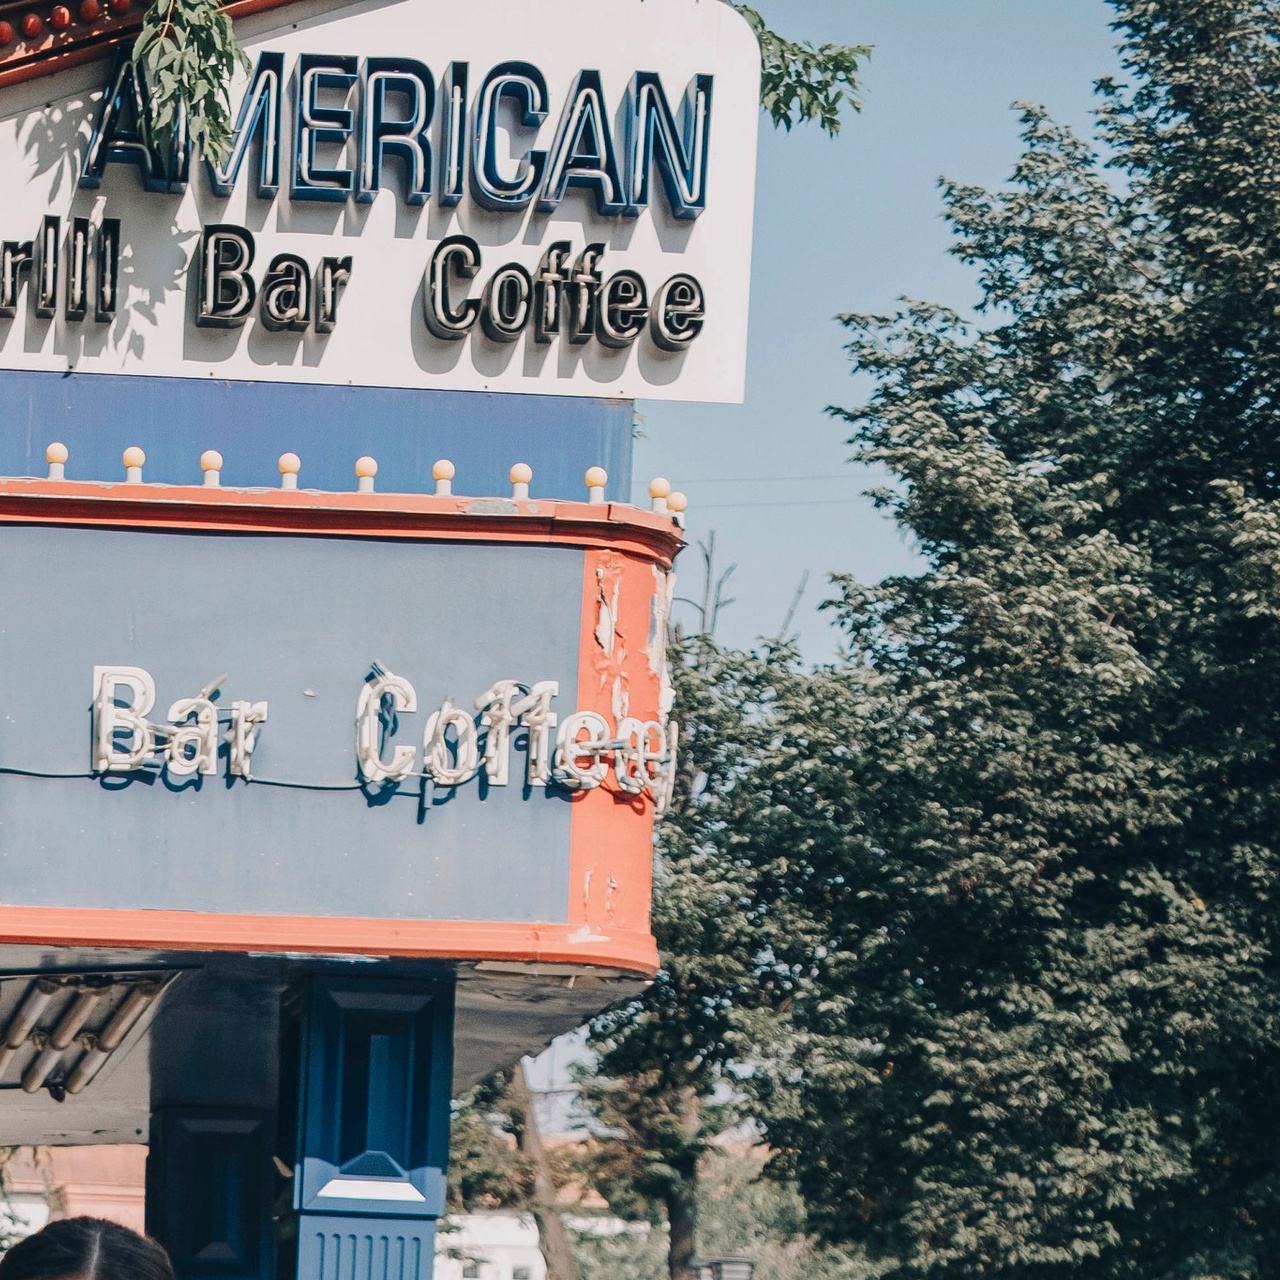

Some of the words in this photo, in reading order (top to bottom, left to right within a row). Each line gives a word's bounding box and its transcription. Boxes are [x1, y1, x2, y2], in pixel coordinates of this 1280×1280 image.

[80, 46, 713, 218] AMERICAN
[195, 224, 353, 329] Bar
[425, 236, 707, 353] Coffee
[92, 665, 270, 776] Bar
